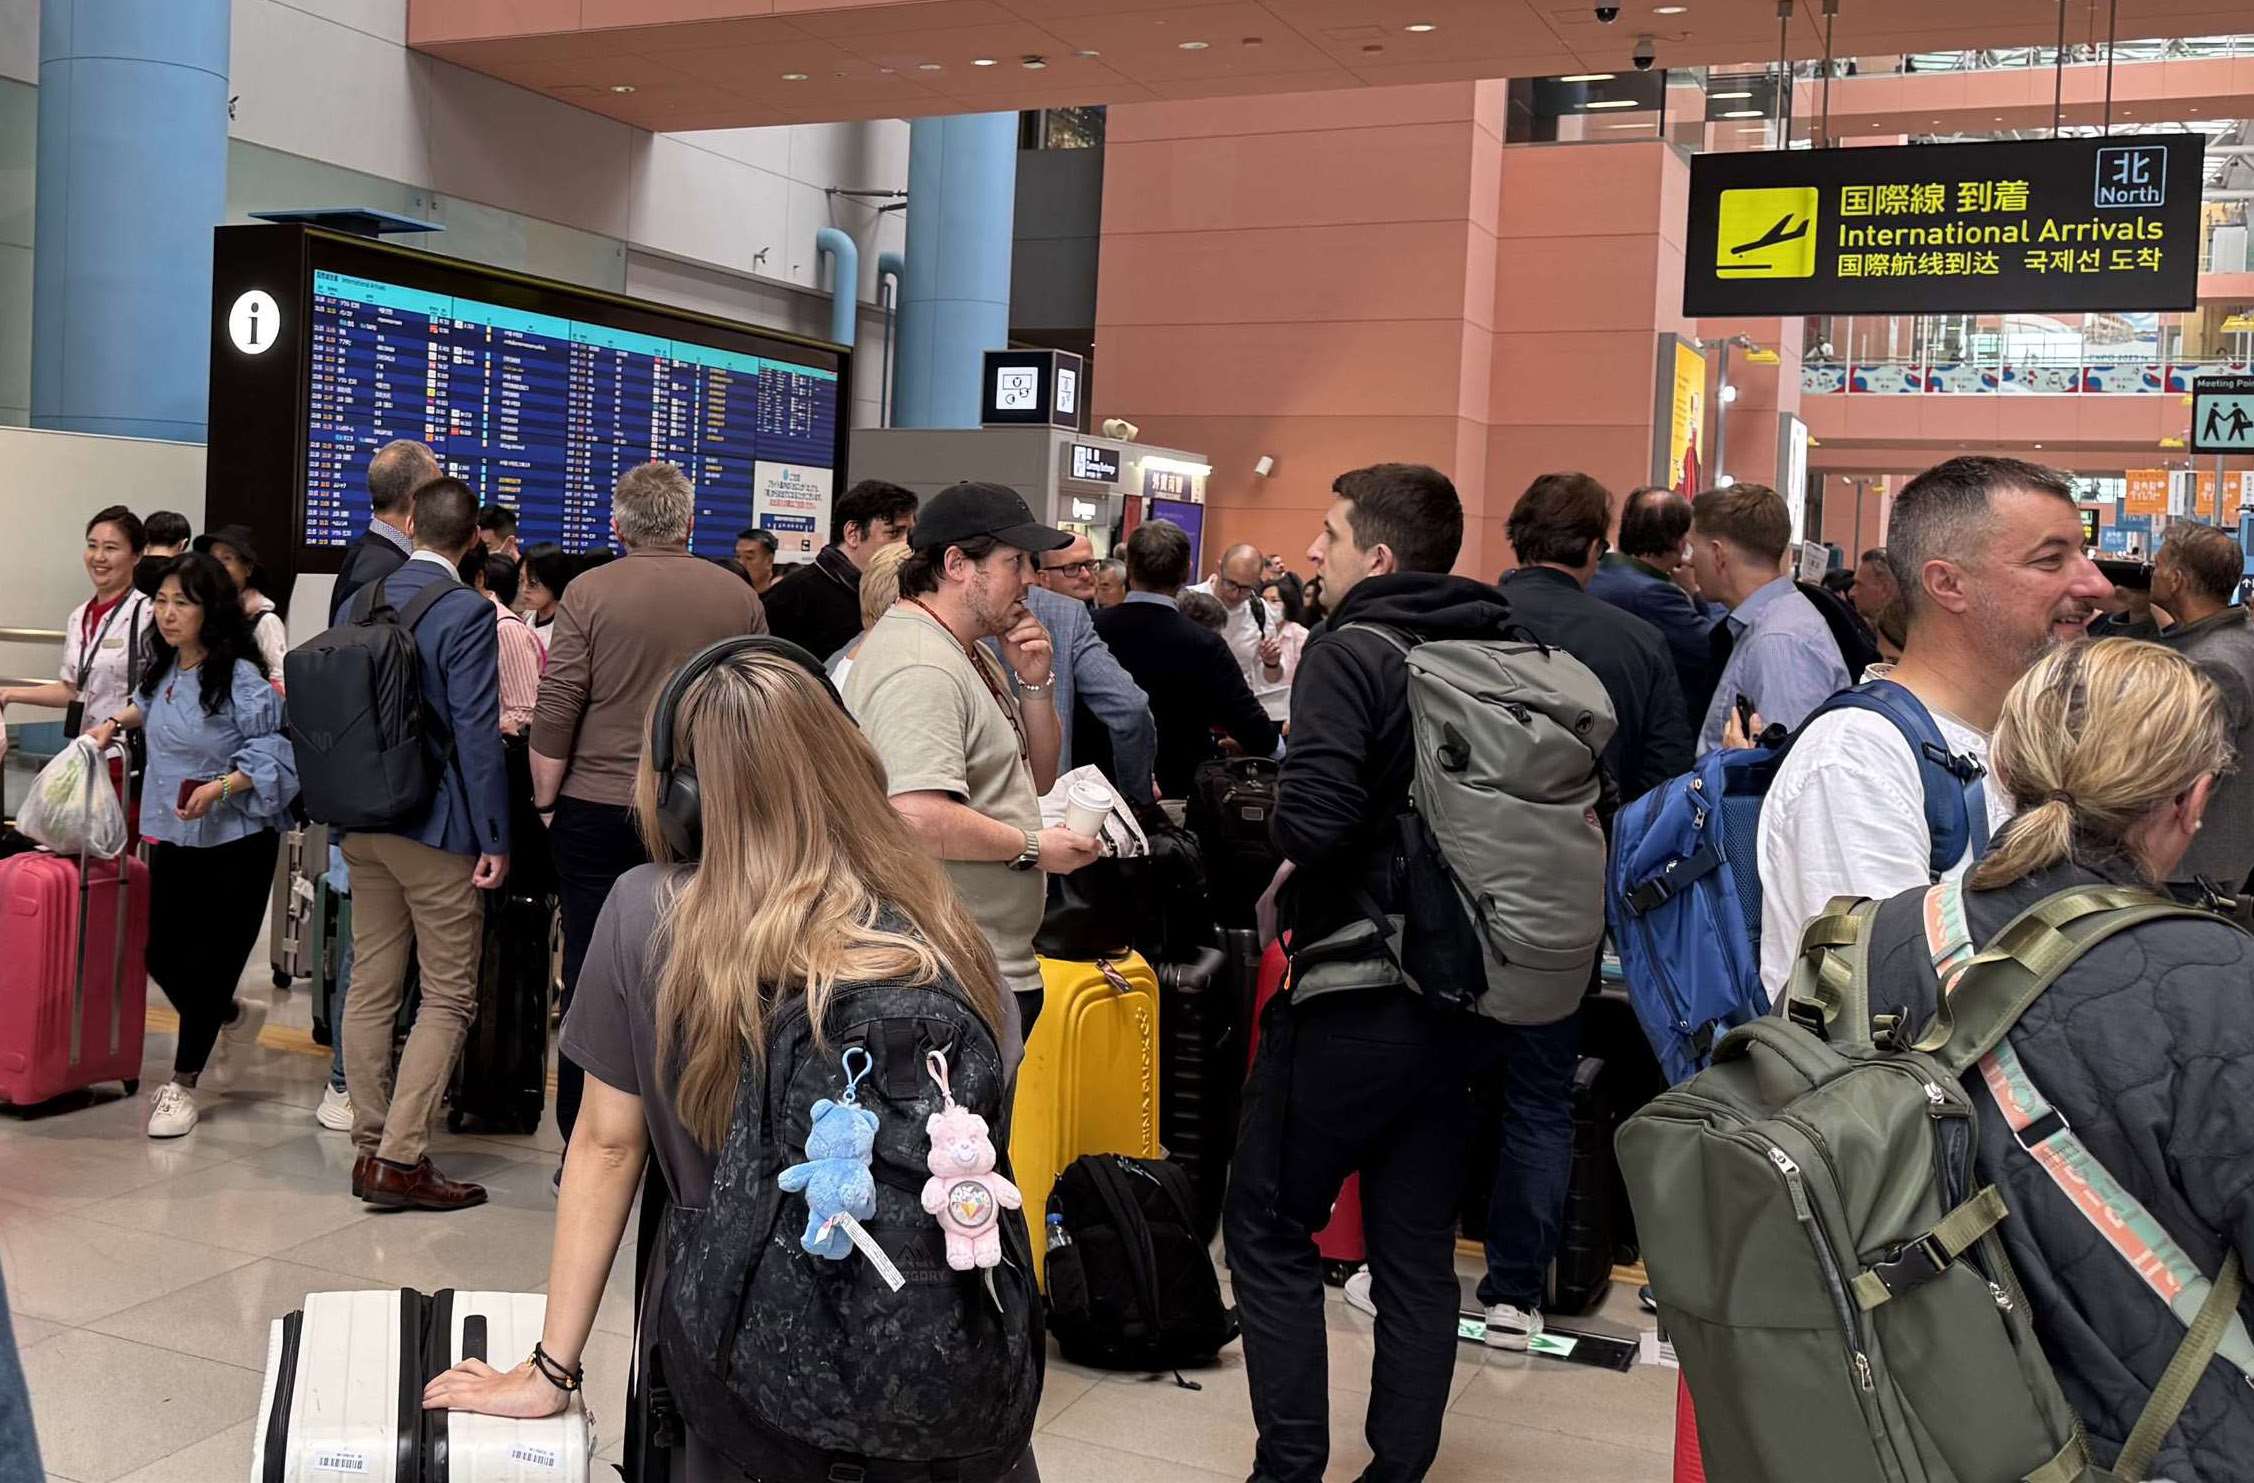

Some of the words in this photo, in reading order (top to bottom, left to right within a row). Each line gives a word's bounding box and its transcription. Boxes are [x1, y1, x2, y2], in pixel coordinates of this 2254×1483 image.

[2112, 152, 2150, 185] 北
[1840, 182, 1946, 217] 国際線
[1956, 179, 2030, 213] 到着
[2099, 185, 2160, 204] North
[1839, 218, 2030, 247] International
[2037, 216, 2164, 243] Arrivals
[2024, 248, 2101, 274] 국제선
[2109, 246, 2163, 272] 도착
[2197, 378, 2235, 389] Meeting
